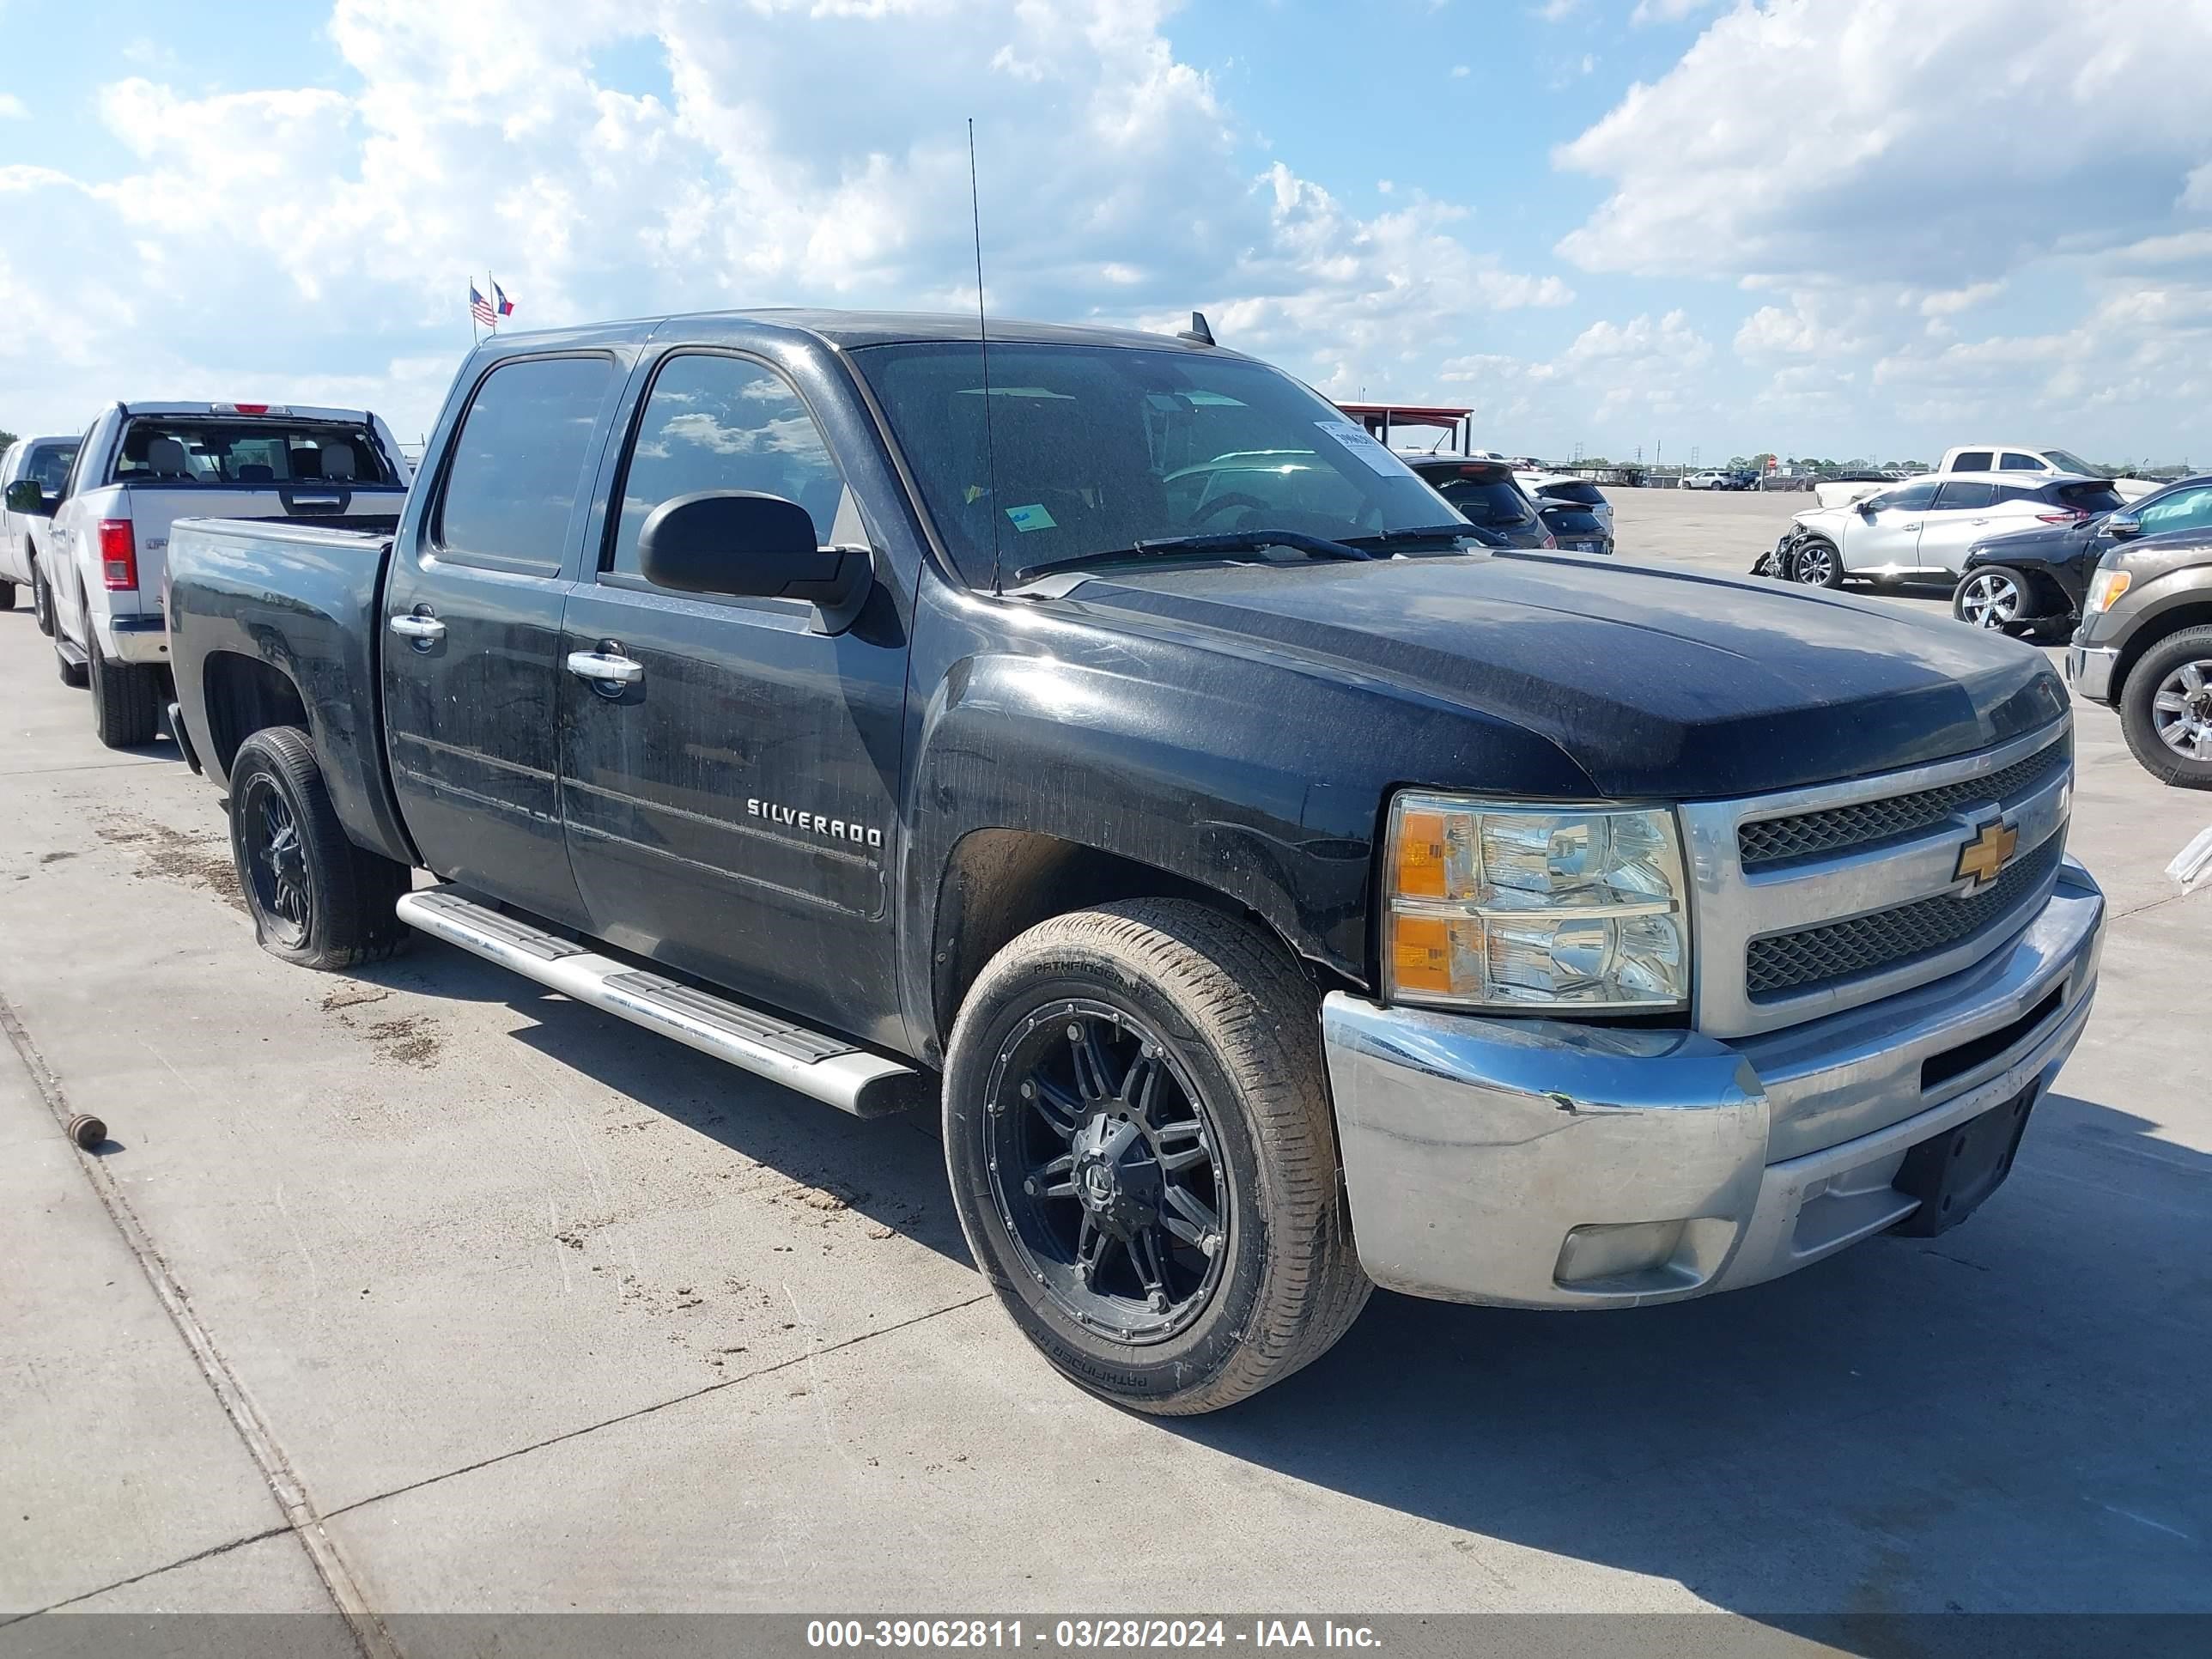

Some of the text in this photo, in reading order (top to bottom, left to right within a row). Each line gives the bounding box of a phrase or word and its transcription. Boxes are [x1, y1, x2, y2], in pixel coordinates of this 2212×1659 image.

[747, 799, 881, 847] SILVERADO
[1034, 961, 1125, 987] PATHFINDER
[1052, 1345, 1148, 1388] PATHFINDER
